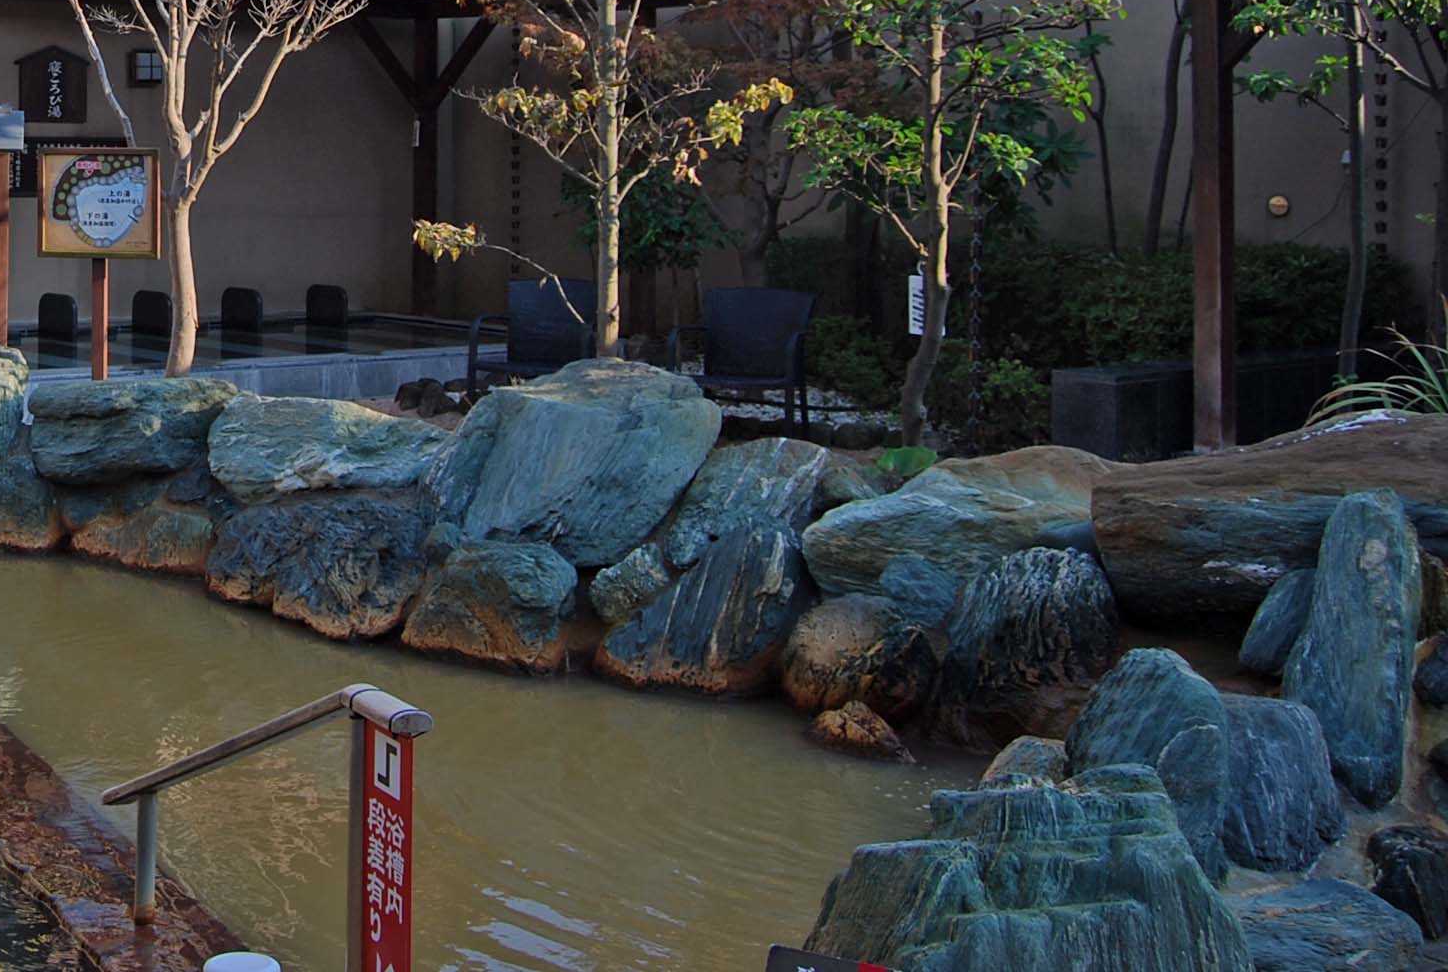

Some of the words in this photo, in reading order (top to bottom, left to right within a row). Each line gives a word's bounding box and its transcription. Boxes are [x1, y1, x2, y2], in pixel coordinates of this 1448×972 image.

[47, 60, 63, 118] 寝ころび湯
[367, 797, 386, 942] 段差有り
[385, 807, 405, 925] 浴槽内
